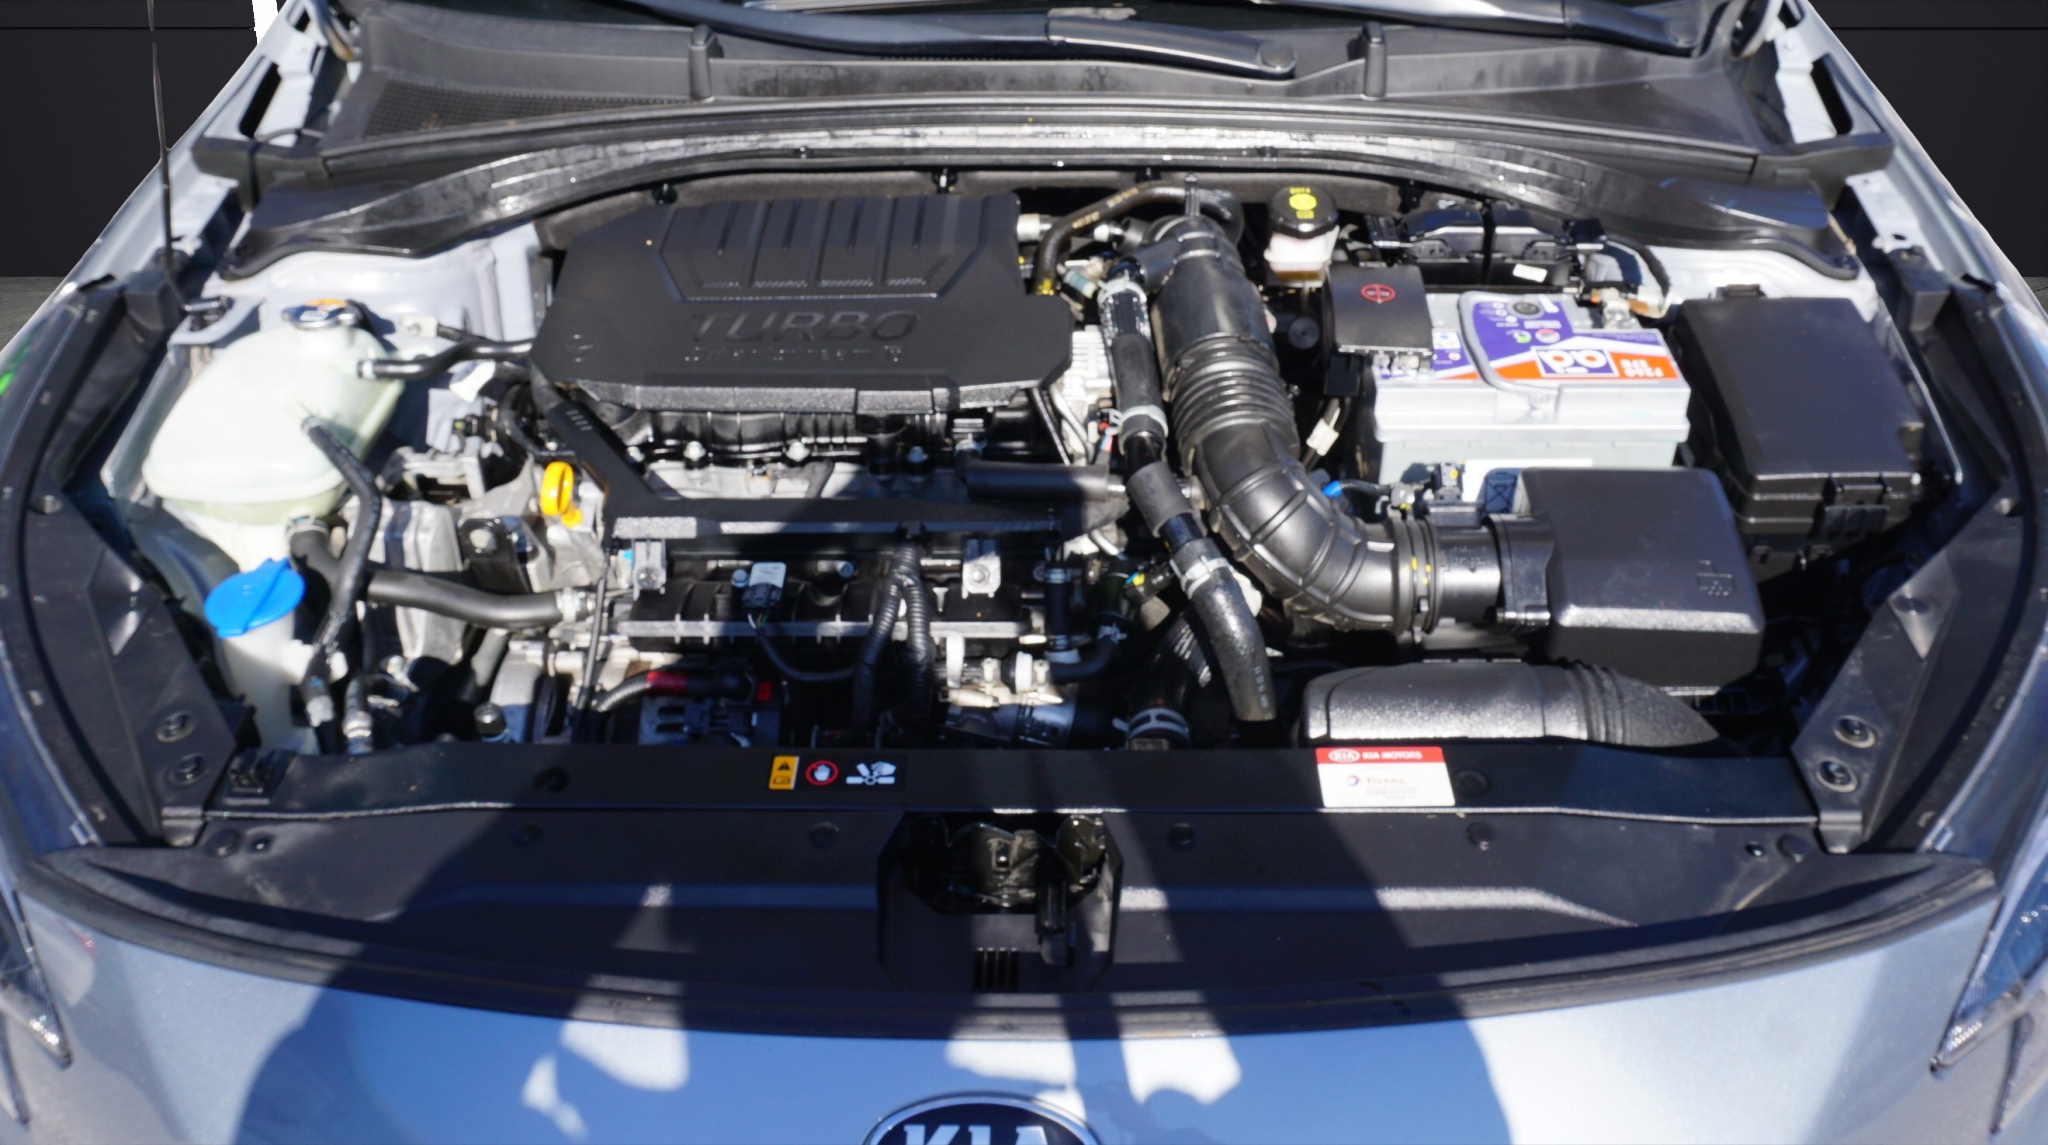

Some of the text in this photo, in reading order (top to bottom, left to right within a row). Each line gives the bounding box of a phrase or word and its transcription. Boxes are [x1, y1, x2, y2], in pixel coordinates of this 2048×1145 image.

[692, 309, 922, 342] TURBO
[1362, 751, 1381, 760] KIA
[1381, 750, 1423, 760] MOTORS
